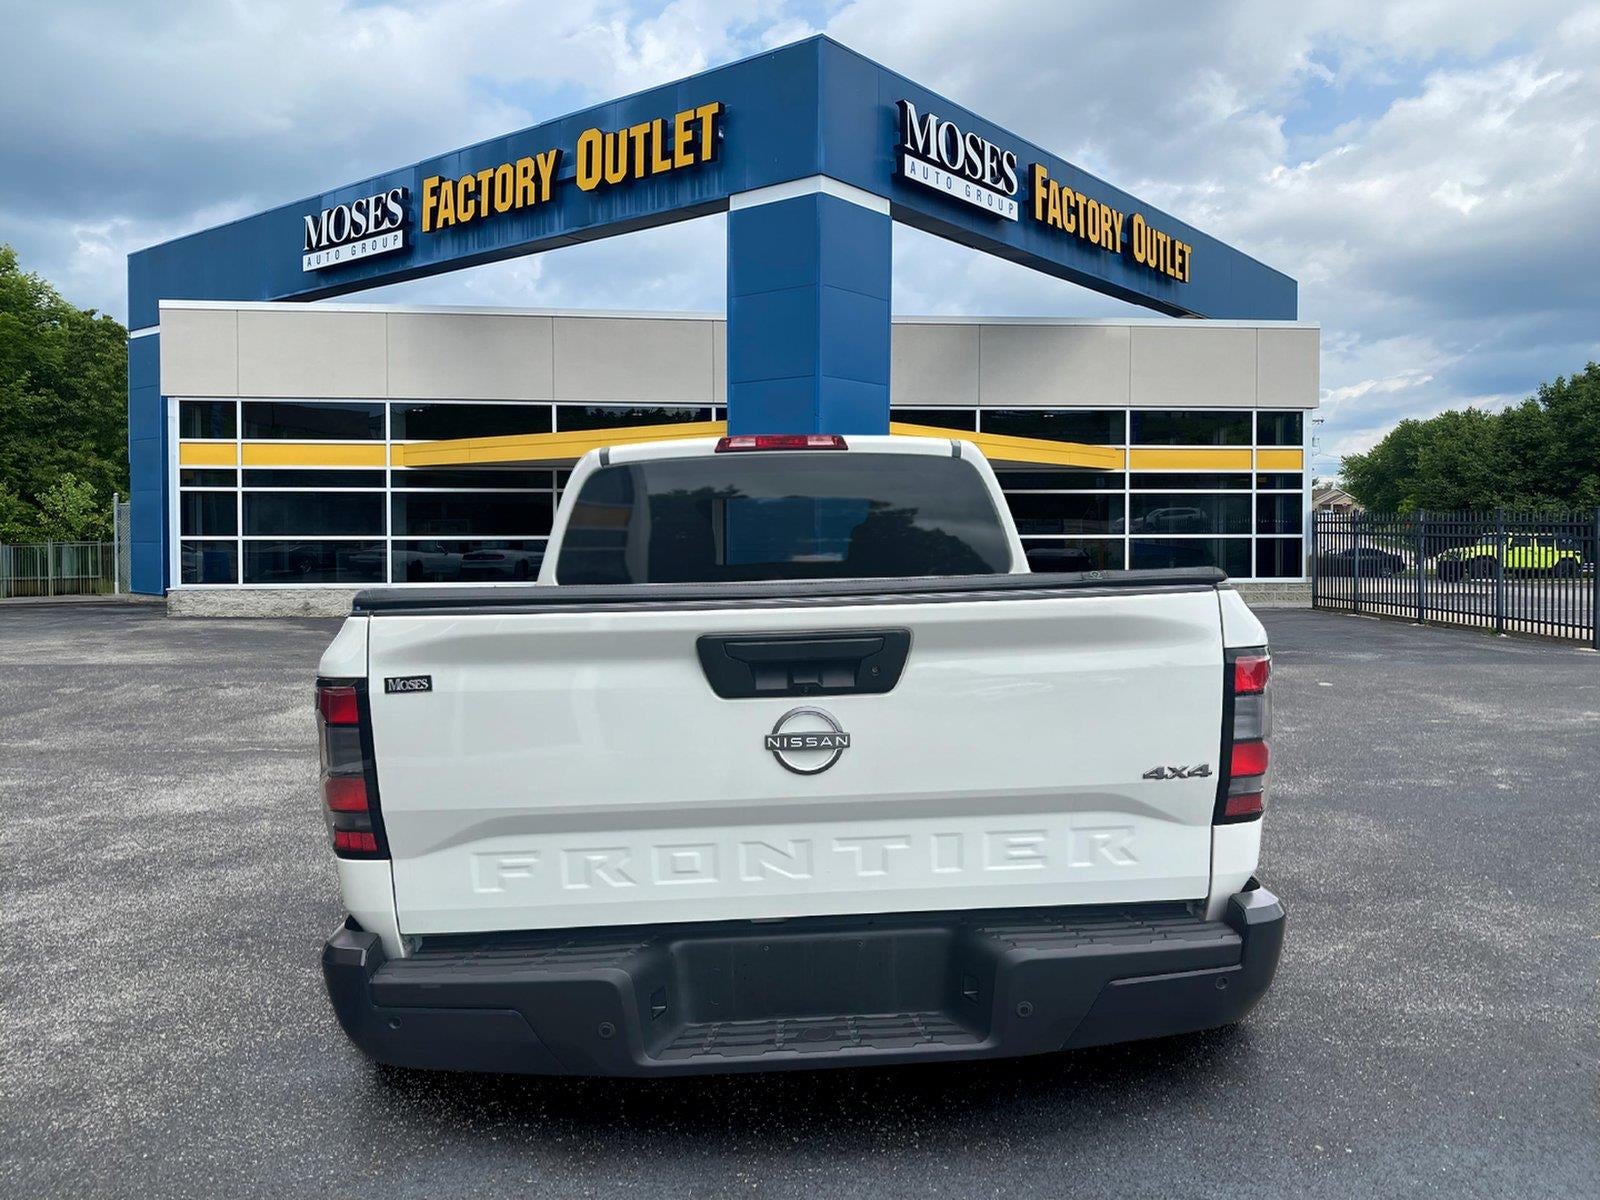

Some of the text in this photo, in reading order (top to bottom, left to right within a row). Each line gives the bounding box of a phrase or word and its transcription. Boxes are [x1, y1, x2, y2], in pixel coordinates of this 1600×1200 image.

[421, 101, 720, 233] FACTORY OUTLET
[904, 100, 1019, 196] MOSES
[910, 161, 1014, 214] AUTO GROUP
[303, 188, 403, 251] MOSES
[307, 234, 399, 268] AUTO GROUP
[1034, 163, 1192, 283] FACTORY OUTLET
[387, 677, 429, 691] MOSES
[767, 734, 850, 748] NISSAN
[471, 825, 1139, 893] FRONTIER
